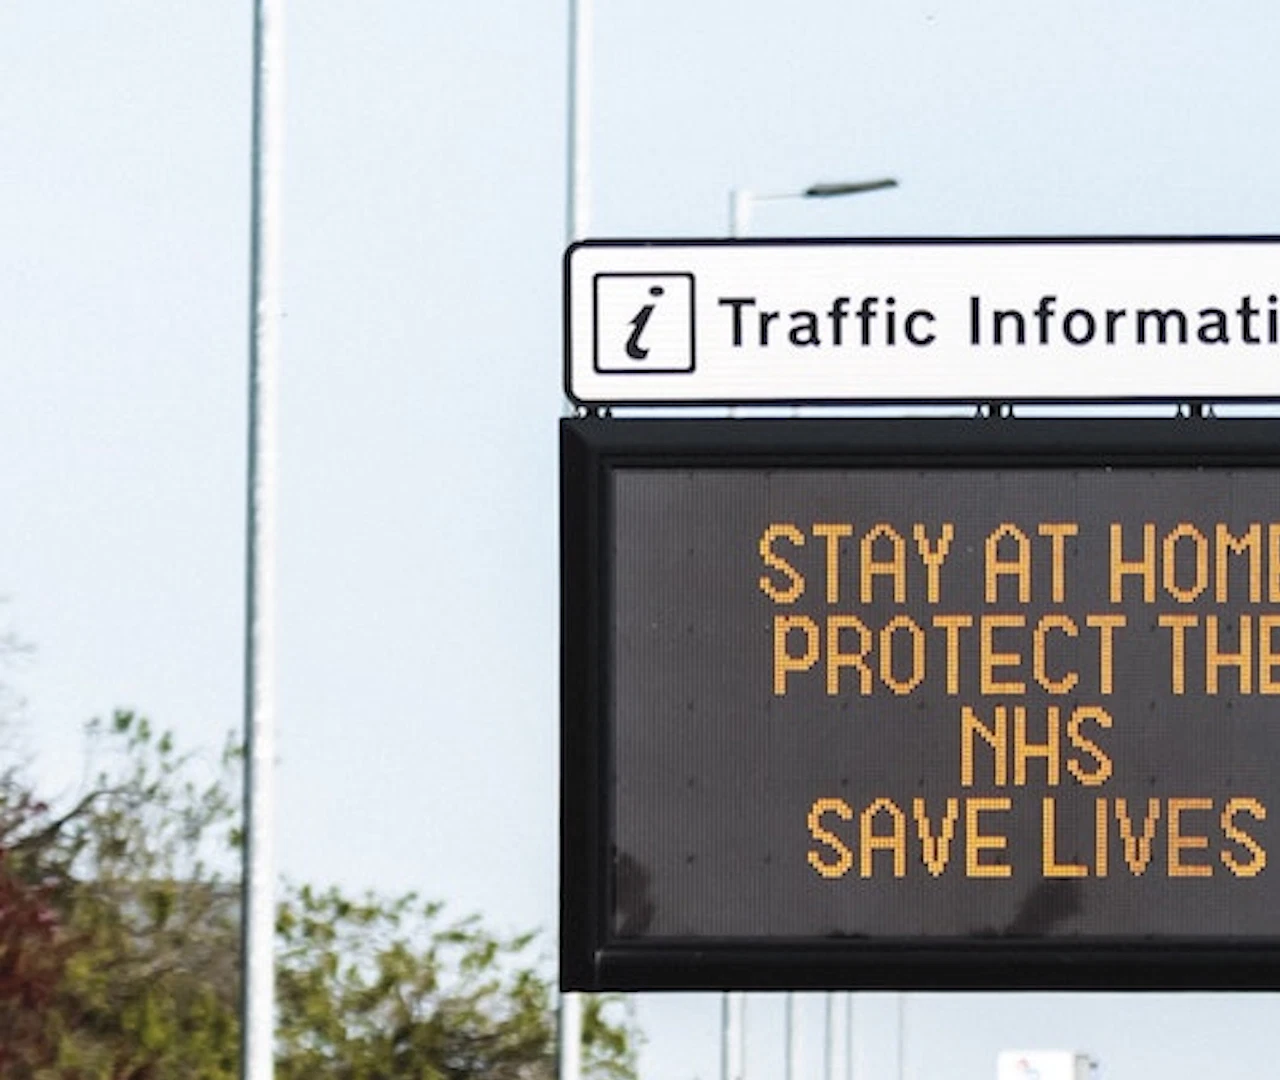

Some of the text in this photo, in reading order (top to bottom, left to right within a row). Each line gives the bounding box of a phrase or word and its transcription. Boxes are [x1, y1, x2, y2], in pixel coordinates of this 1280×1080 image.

[718, 297, 936, 346] Traffic
[759, 523, 953, 603] STAY
[985, 523, 1077, 603] AT
[774, 614, 1126, 695] PROTECT
[961, 705, 1113, 786] NHS
[807, 797, 1267, 877] SAVE LIVES
